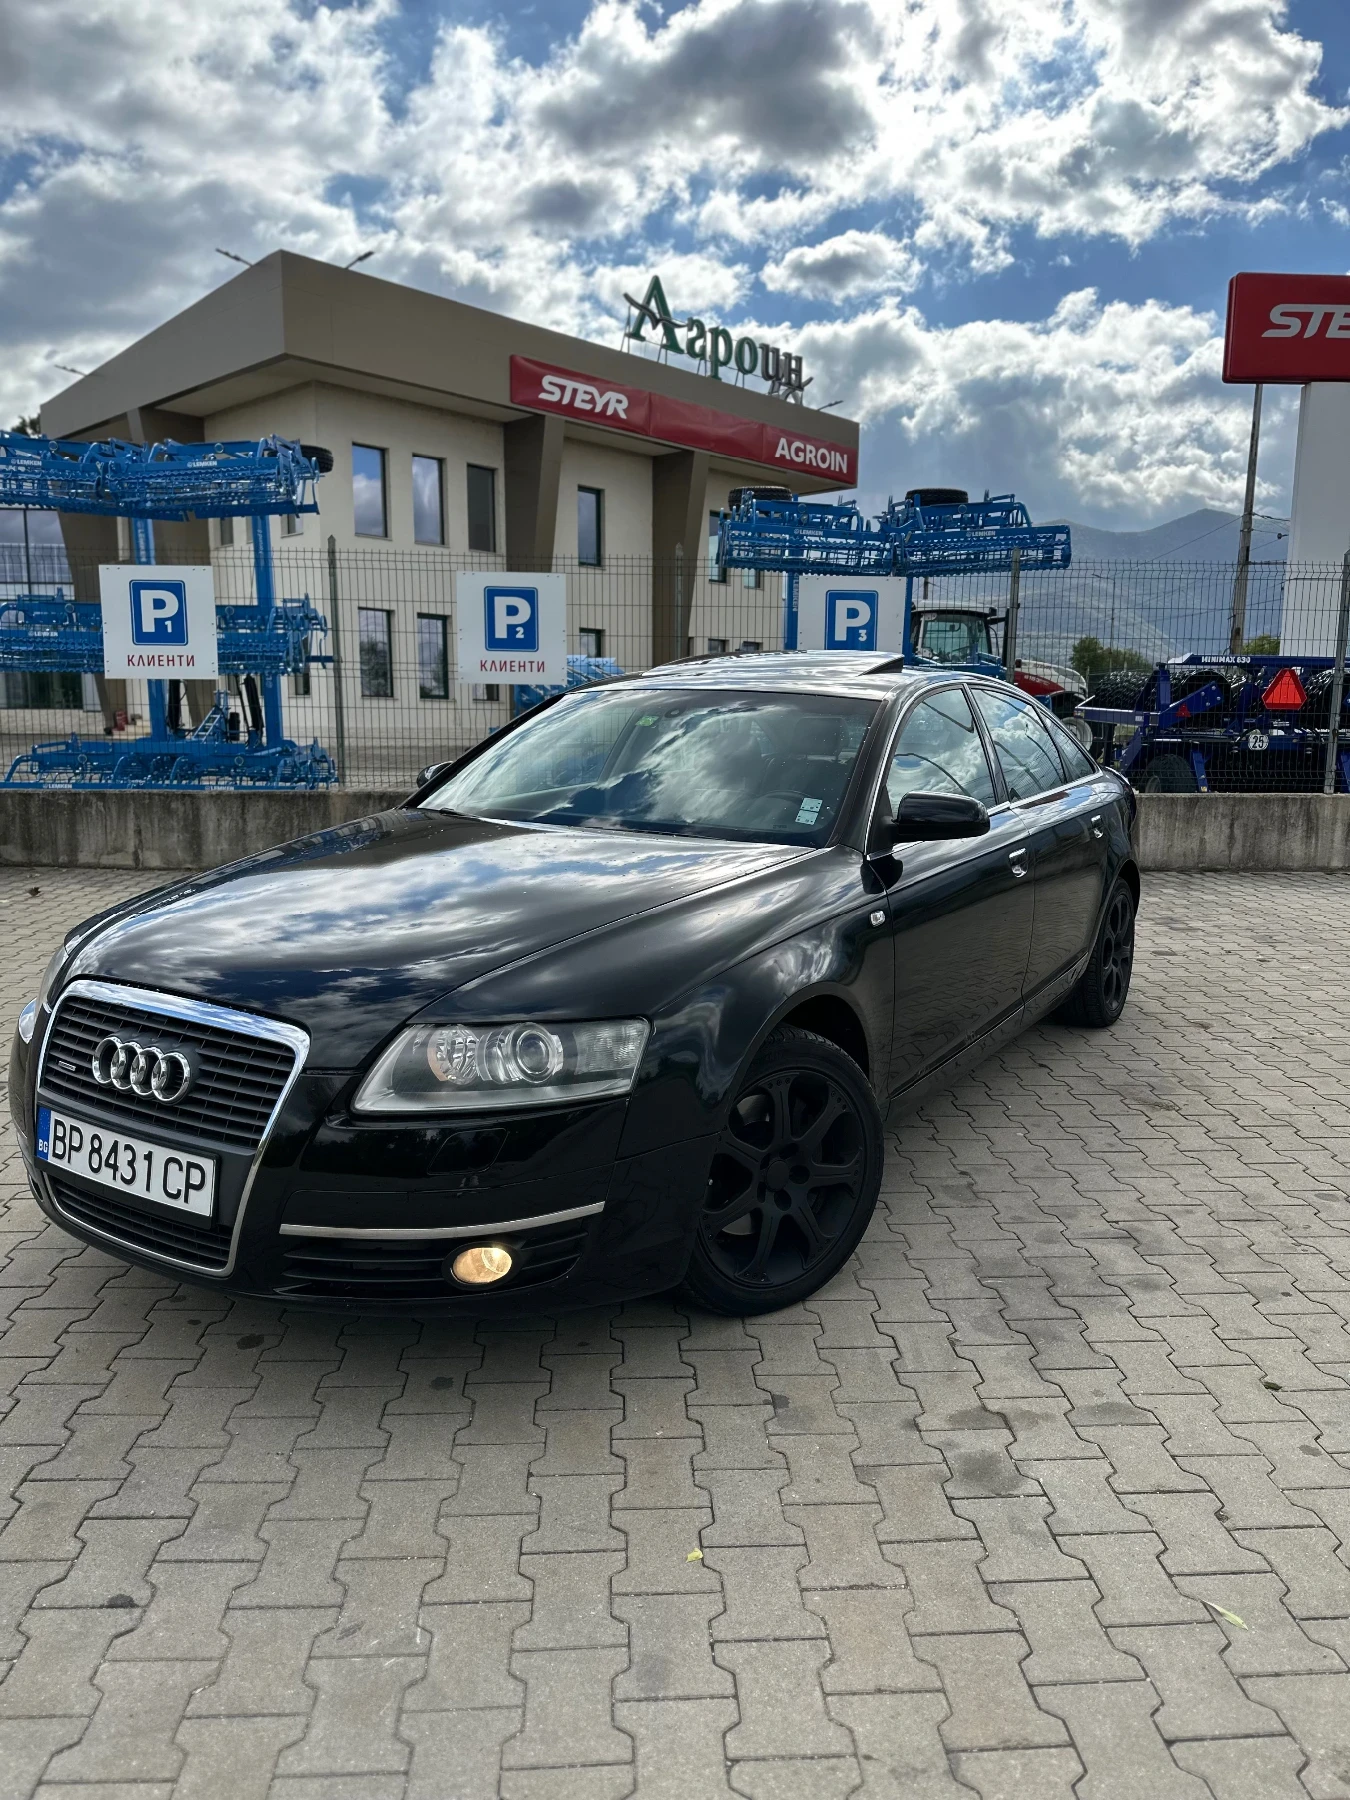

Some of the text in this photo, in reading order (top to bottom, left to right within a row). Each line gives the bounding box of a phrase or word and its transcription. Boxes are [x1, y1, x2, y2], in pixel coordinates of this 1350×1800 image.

[538, 374, 629, 419] STEYR
[775, 437, 848, 474] AGROIN
[15, 459, 42, 467] LEMKEN
[192, 460, 218, 468] LEMKEN
[127, 654, 196, 668] КЛИЕНТИ
[480, 659, 546, 673] КЛИЕНТИ
[1201, 656, 1236, 664] MINIMAX
[1252, 735, 1265, 749] 25
[39, 1139, 49, 1153] BG
[52, 1118, 206, 1204] BP 8431 CP
